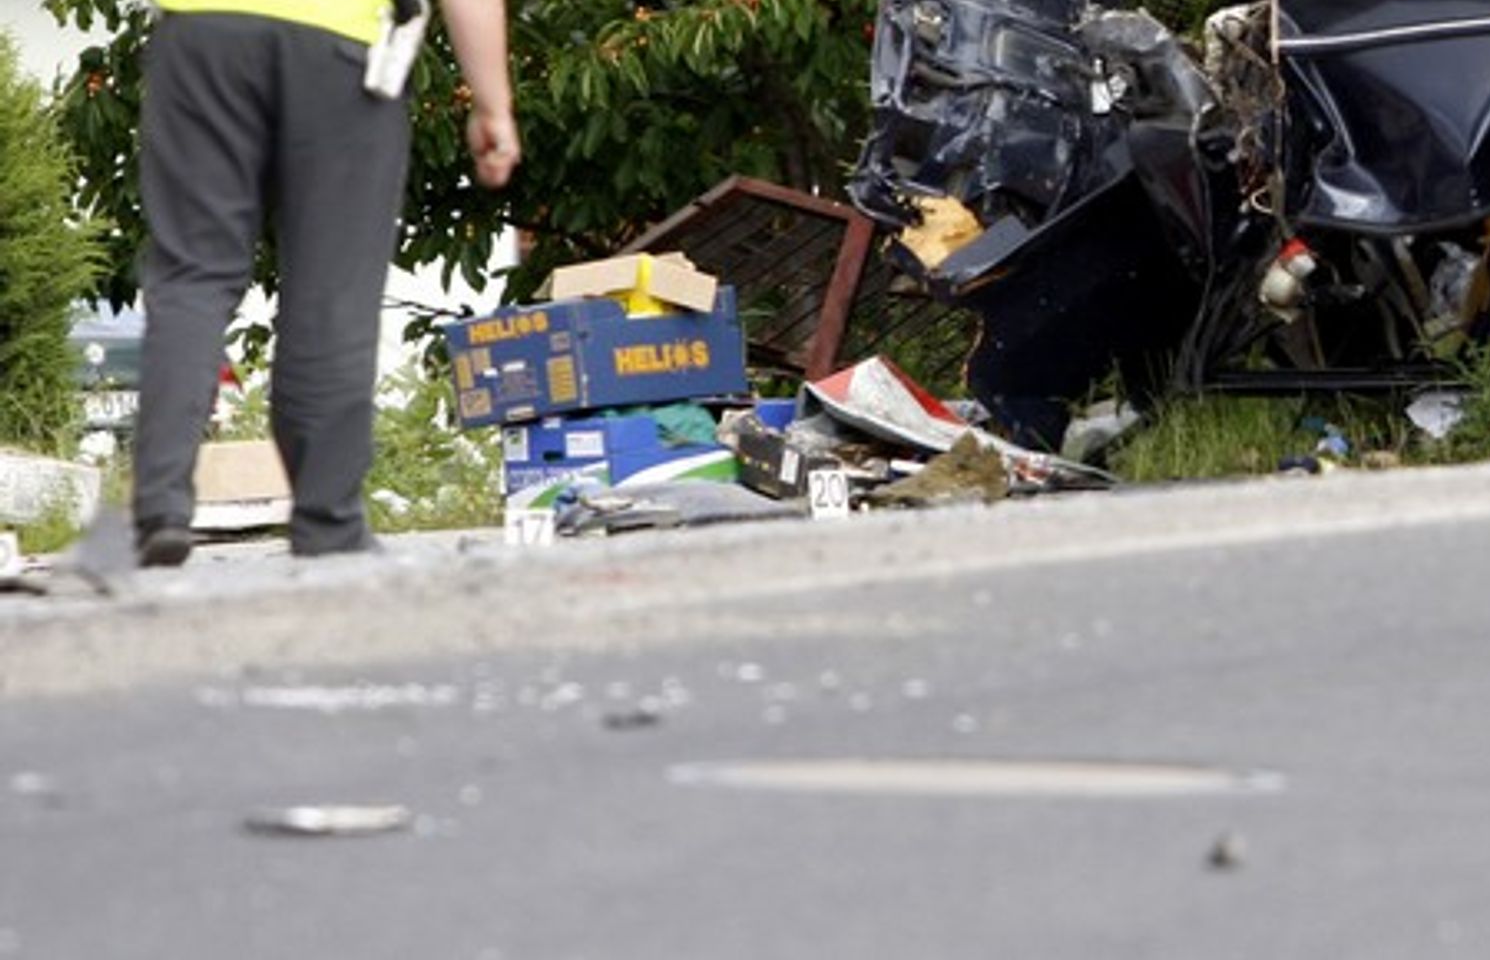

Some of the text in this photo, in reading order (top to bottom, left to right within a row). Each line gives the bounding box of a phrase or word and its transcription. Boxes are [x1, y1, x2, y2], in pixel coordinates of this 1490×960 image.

[468, 311, 548, 344] HELIOS
[613, 339, 710, 376] HELIOS
[813, 472, 845, 508] 20
